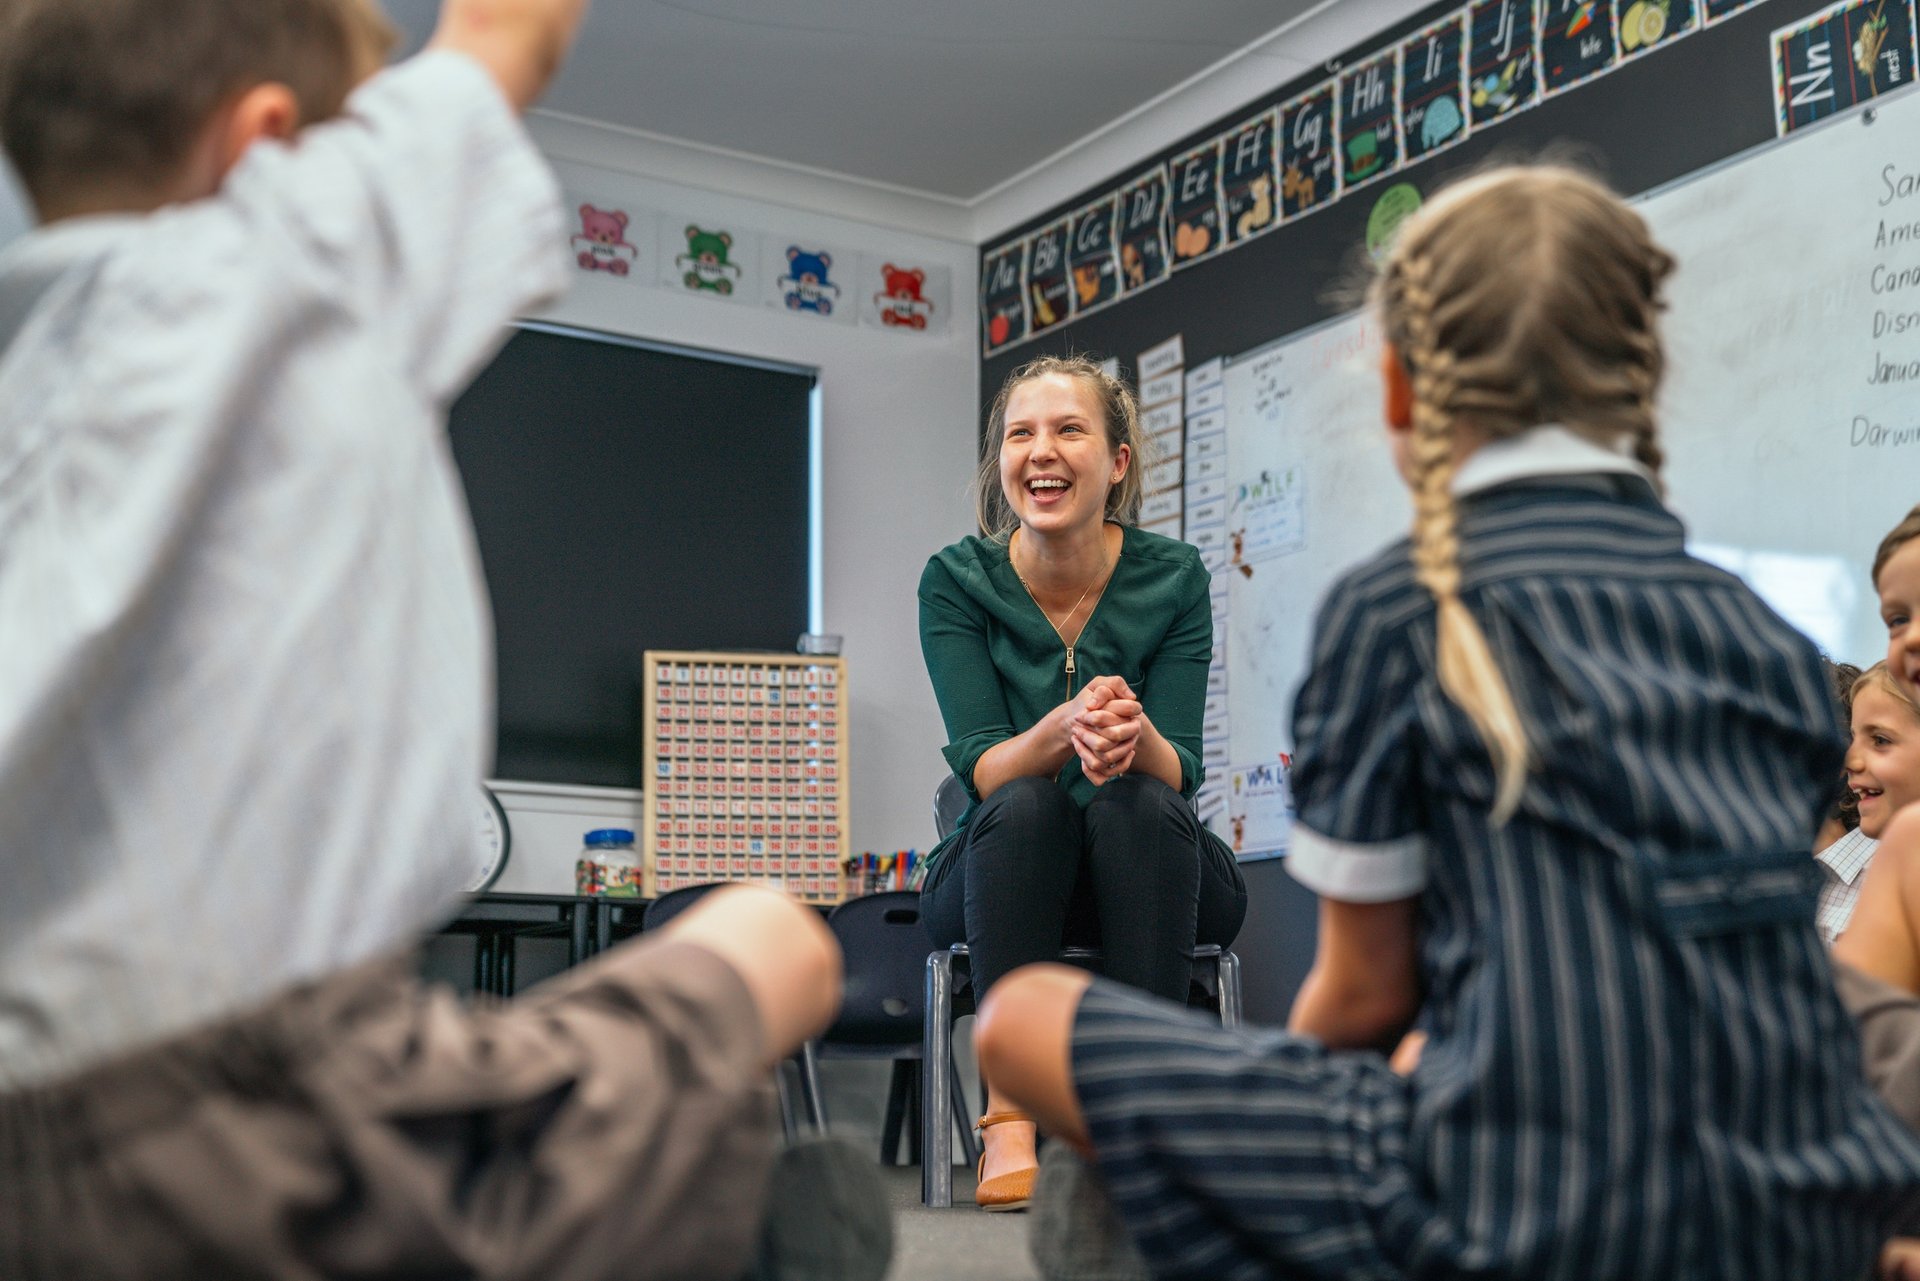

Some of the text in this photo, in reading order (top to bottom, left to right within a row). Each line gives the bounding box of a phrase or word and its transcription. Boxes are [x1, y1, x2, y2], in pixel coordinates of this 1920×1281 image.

[1423, 36, 1443, 83] Ii
[1789, 40, 1836, 107] Nn
[1879, 48, 1901, 82] nest
[1351, 66, 1385, 117] Hh
[1235, 124, 1266, 175] Ff
[1293, 103, 1323, 159] Gg
[1181, 160, 1209, 202] Ee
[1130, 183, 1157, 229] Dd
[1077, 212, 1104, 251] Cc
[990, 258, 1015, 294] Aa
[1034, 235, 1058, 276] Bb
